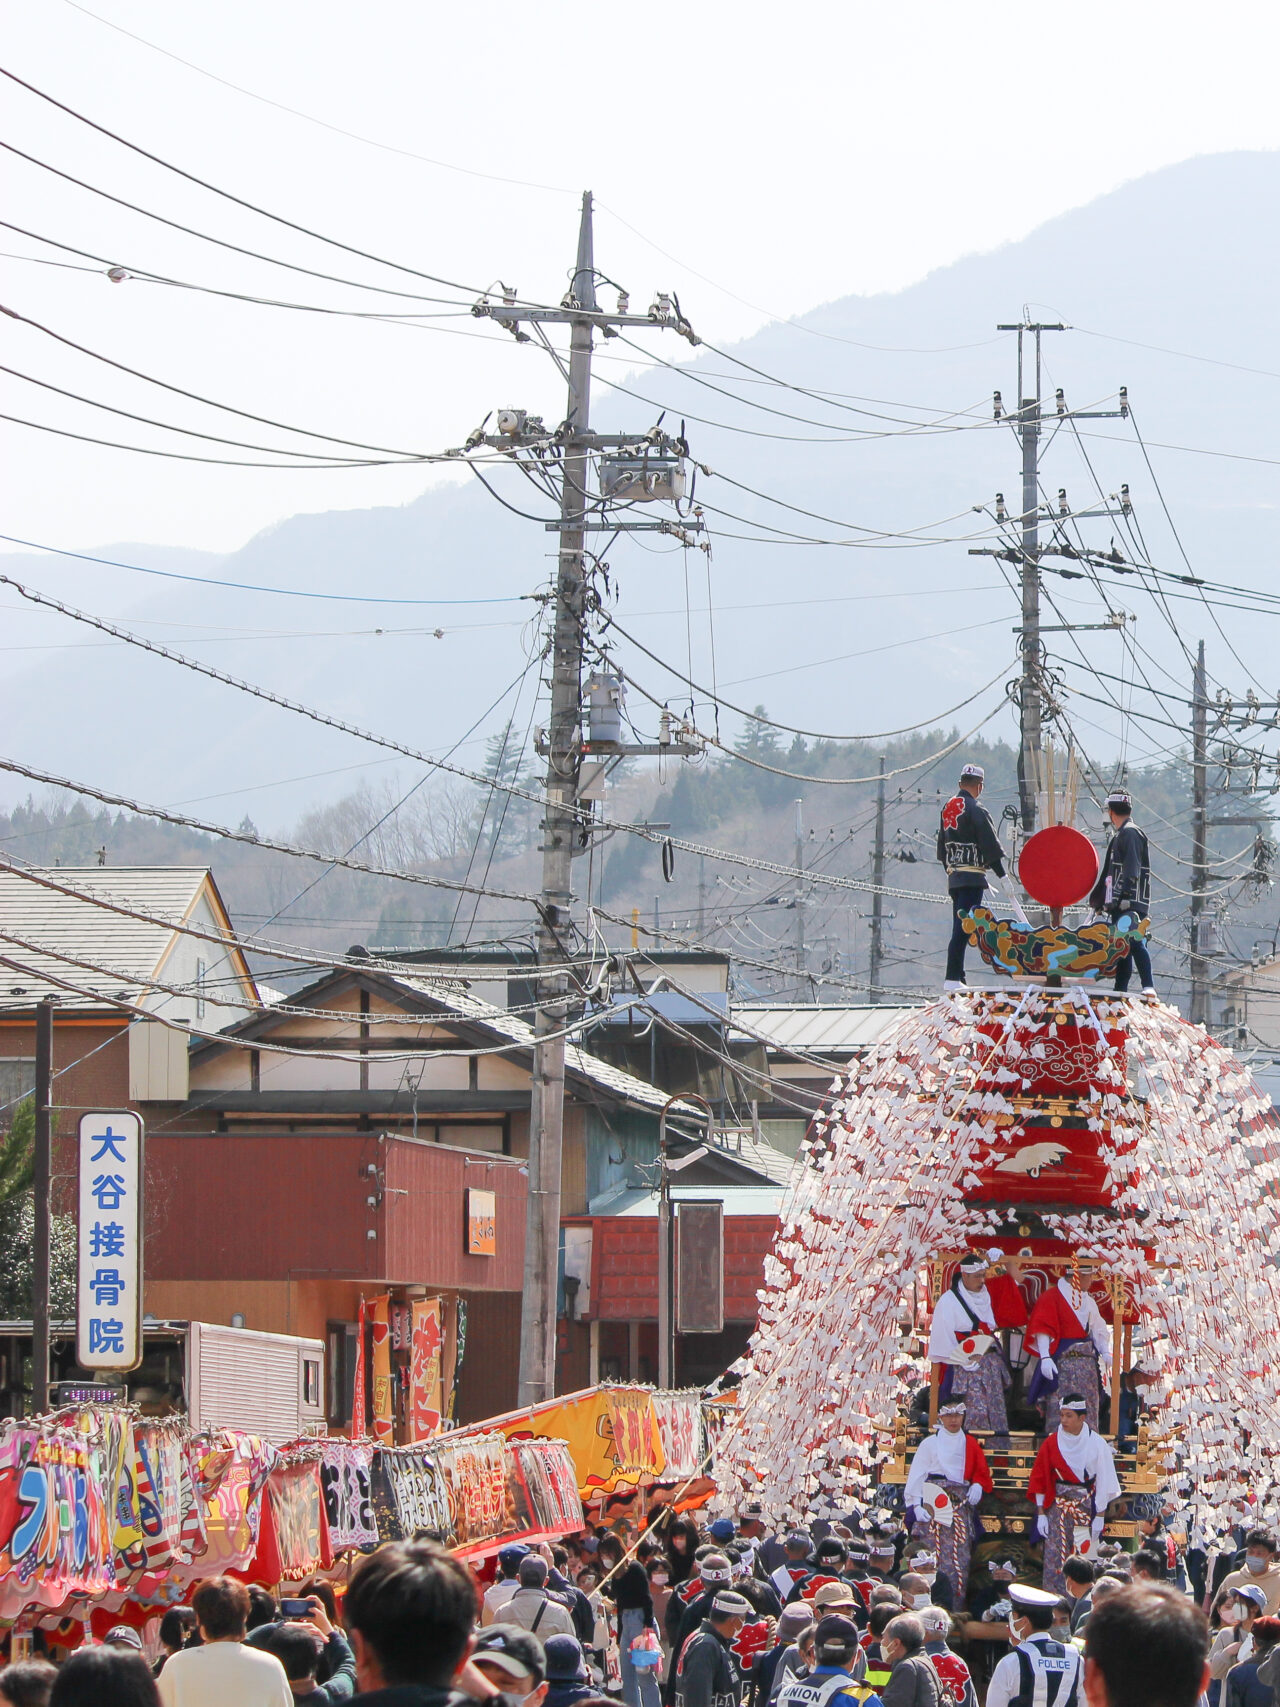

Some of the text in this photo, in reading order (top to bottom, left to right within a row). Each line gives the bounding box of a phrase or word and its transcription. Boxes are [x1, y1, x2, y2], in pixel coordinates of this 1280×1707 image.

[89, 1126, 127, 1354] 大谷接骨院
[1038, 1659, 1071, 1669] POLICE
[784, 1687, 822, 1703] UNION
